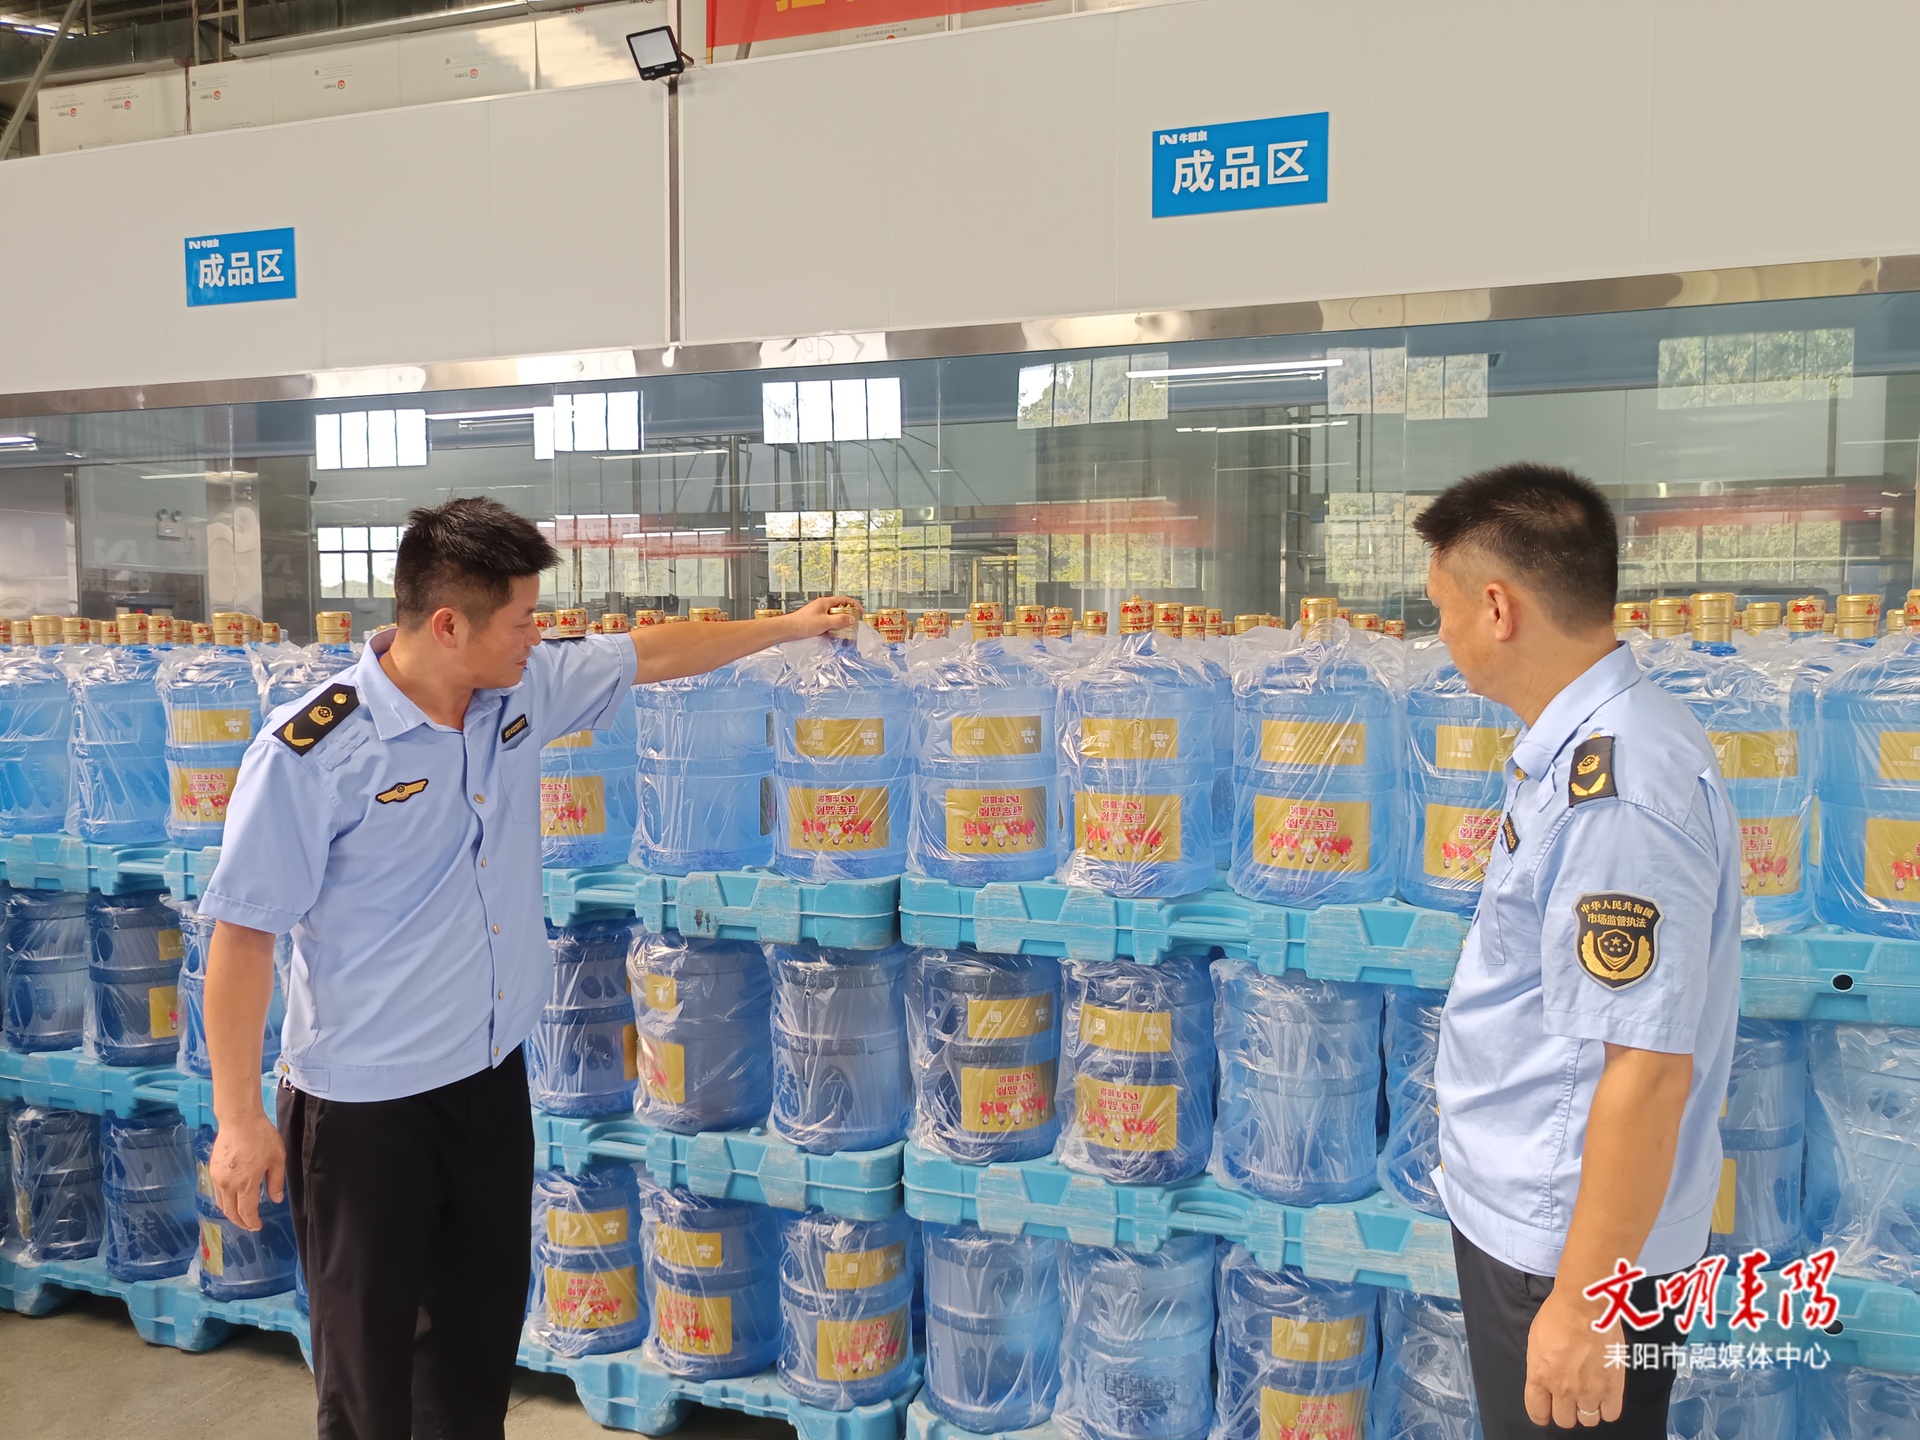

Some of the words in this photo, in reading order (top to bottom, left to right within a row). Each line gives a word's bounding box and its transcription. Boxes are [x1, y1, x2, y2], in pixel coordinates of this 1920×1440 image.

[1172, 140, 1309, 195] 成品区
[199, 249, 285, 289] 成品区
[541, 792, 572, 802] 冠军品
[814, 805, 859, 815] 冠军品质
[978, 805, 1023, 817] 冠军品质
[1100, 811, 1146, 823] 冠军品质
[1285, 817, 1338, 832] 冠军品质
[1458, 826, 1498, 840] 军品质
[1581, 900, 1655, 919] 中华人民共和国
[1588, 913, 1647, 928] 市场监管执法
[995, 1081, 1038, 1097] 冠军品质
